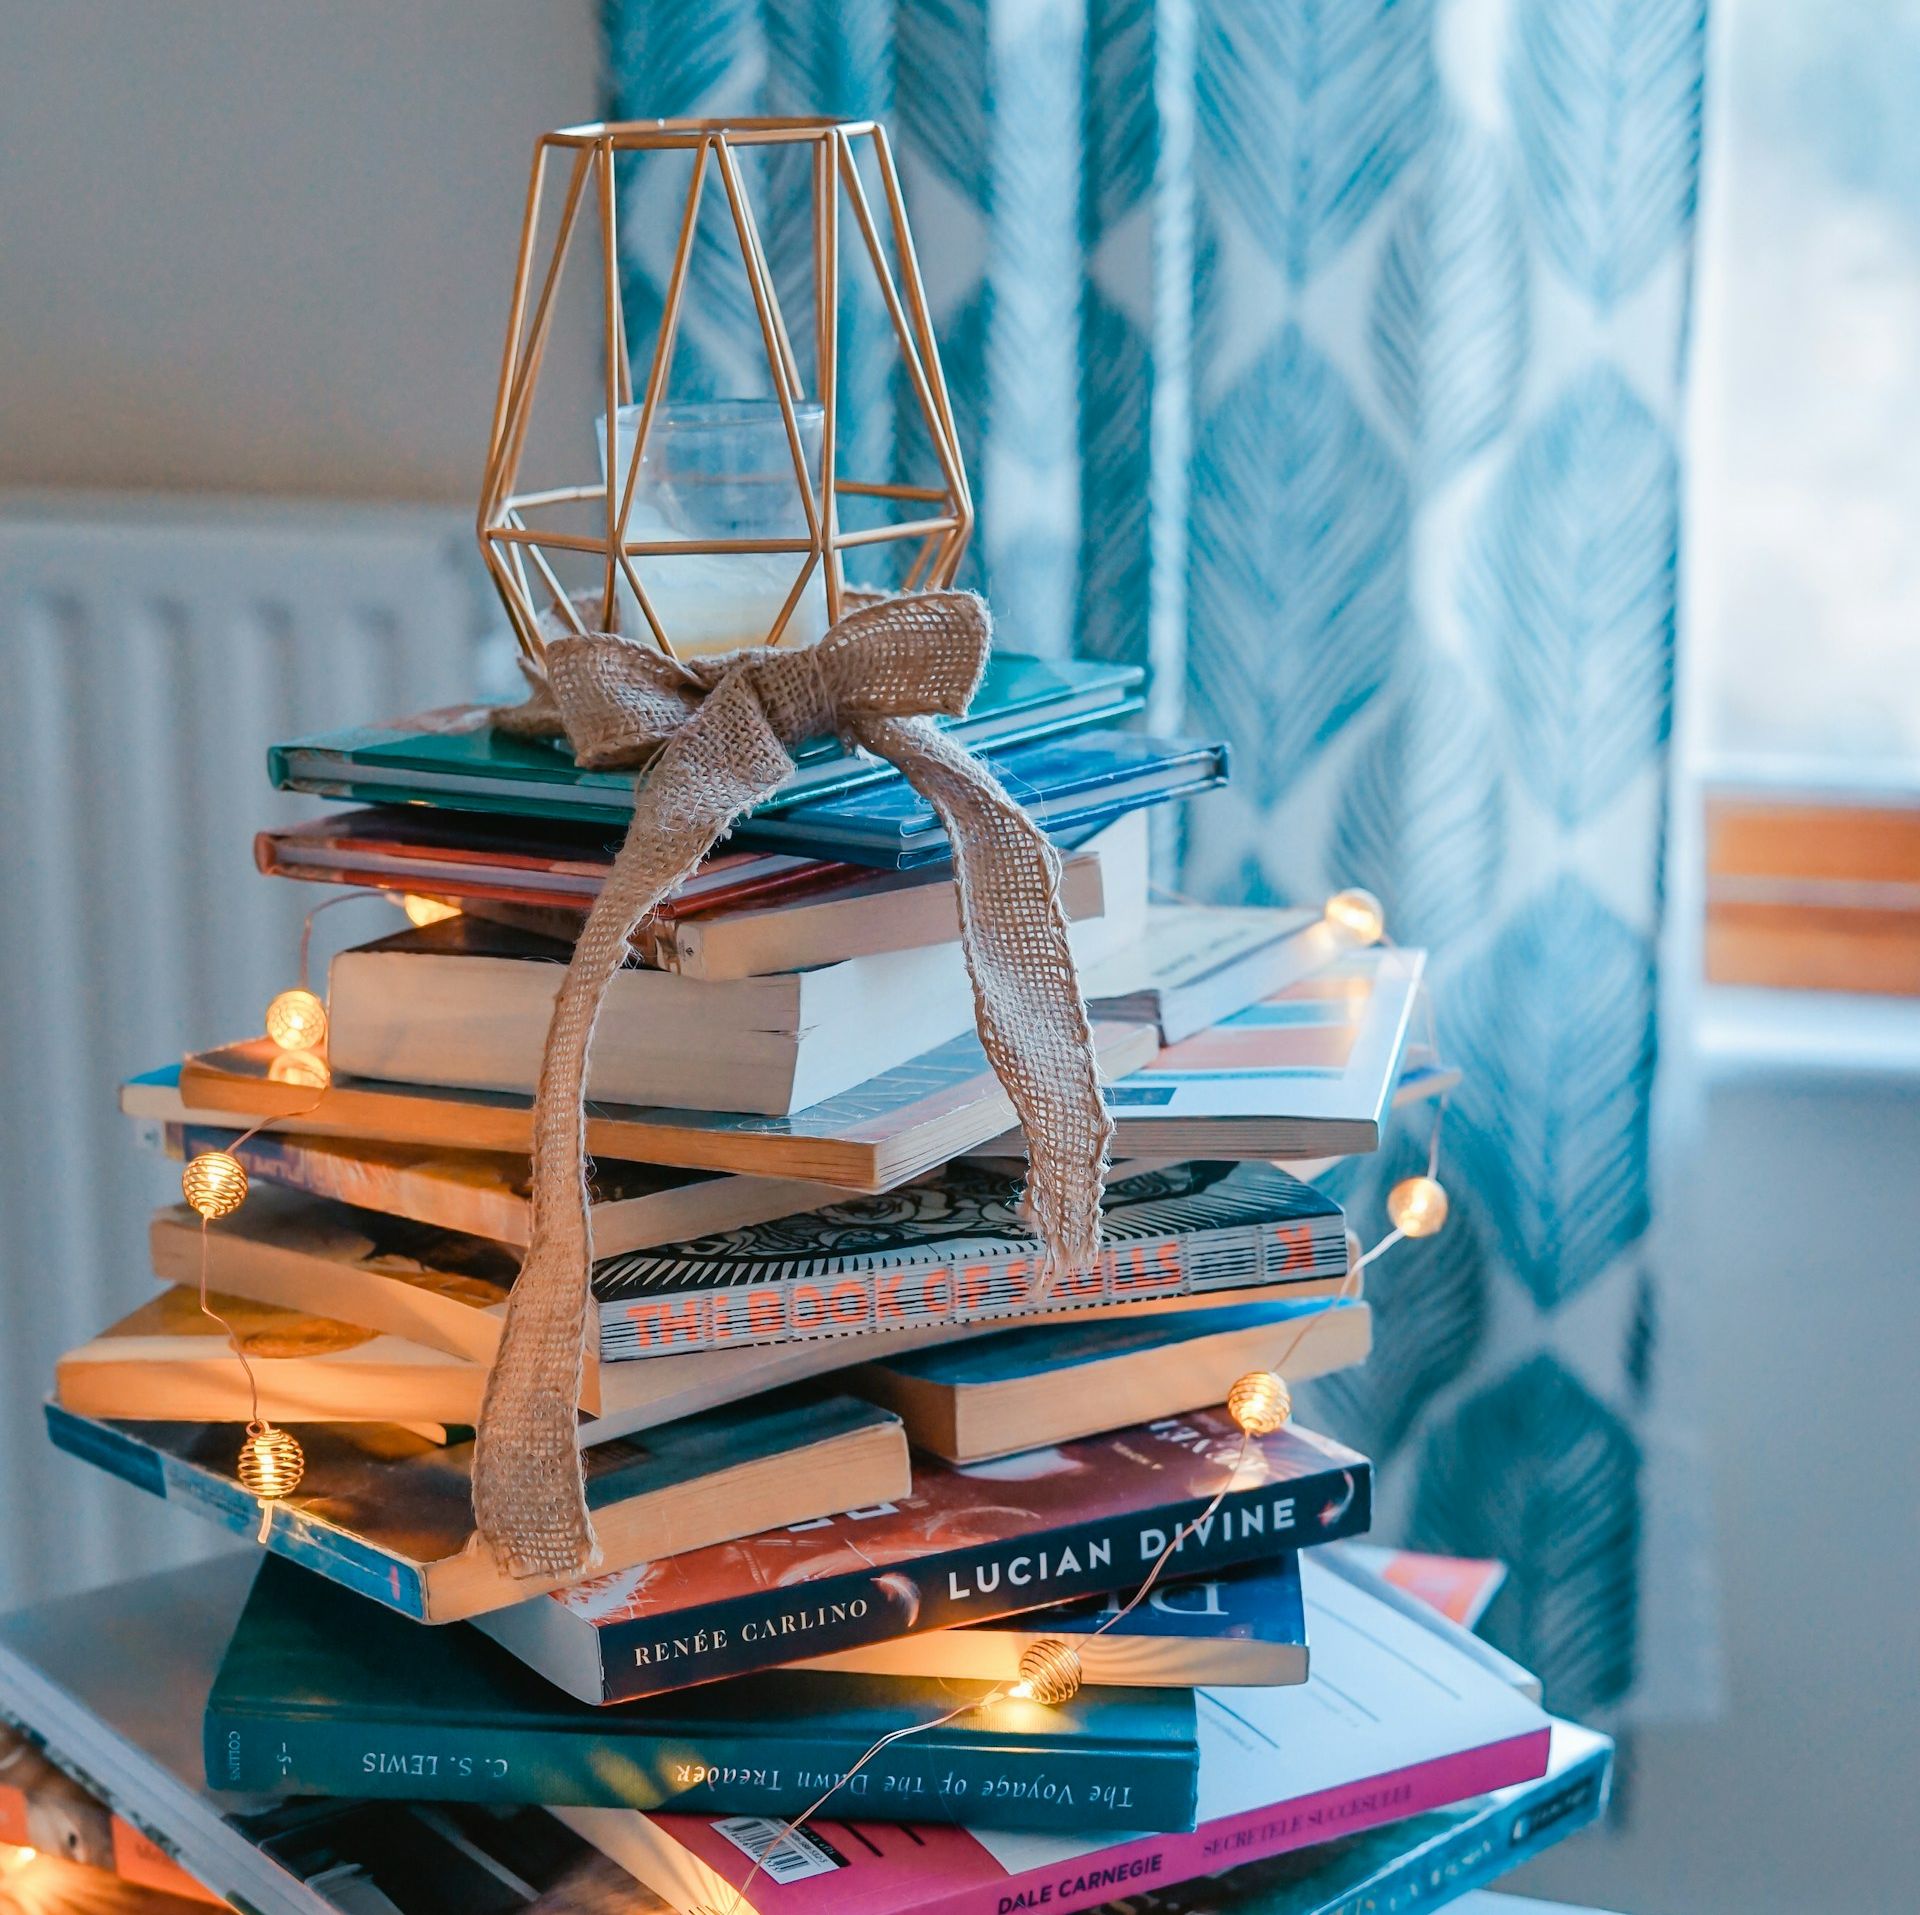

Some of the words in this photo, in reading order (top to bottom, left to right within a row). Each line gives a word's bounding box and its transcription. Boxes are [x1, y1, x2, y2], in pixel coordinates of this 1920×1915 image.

[626, 1296, 731, 1348] THE
[747, 1274, 906, 1334] BOOK
[922, 1264, 990, 1312] OF
[949, 1538, 1111, 1600] LUCIAN
[1140, 1498, 1296, 1560] DIVINE
[634, 1629, 728, 1667] RENÉE
[741, 1599, 868, 1642] CARLINO
[363, 1752, 438, 1776] LEWIS
[449, 1756, 473, 1777] S.
[485, 1758, 508, 1778] C.
[798, 1772, 869, 1795] Dawn
[981, 1774, 1074, 1805] Voyage
[1089, 1786, 1133, 1809] The
[998, 1885, 1052, 1915] DALE
[1058, 1854, 1163, 1898] CARNEGIE
